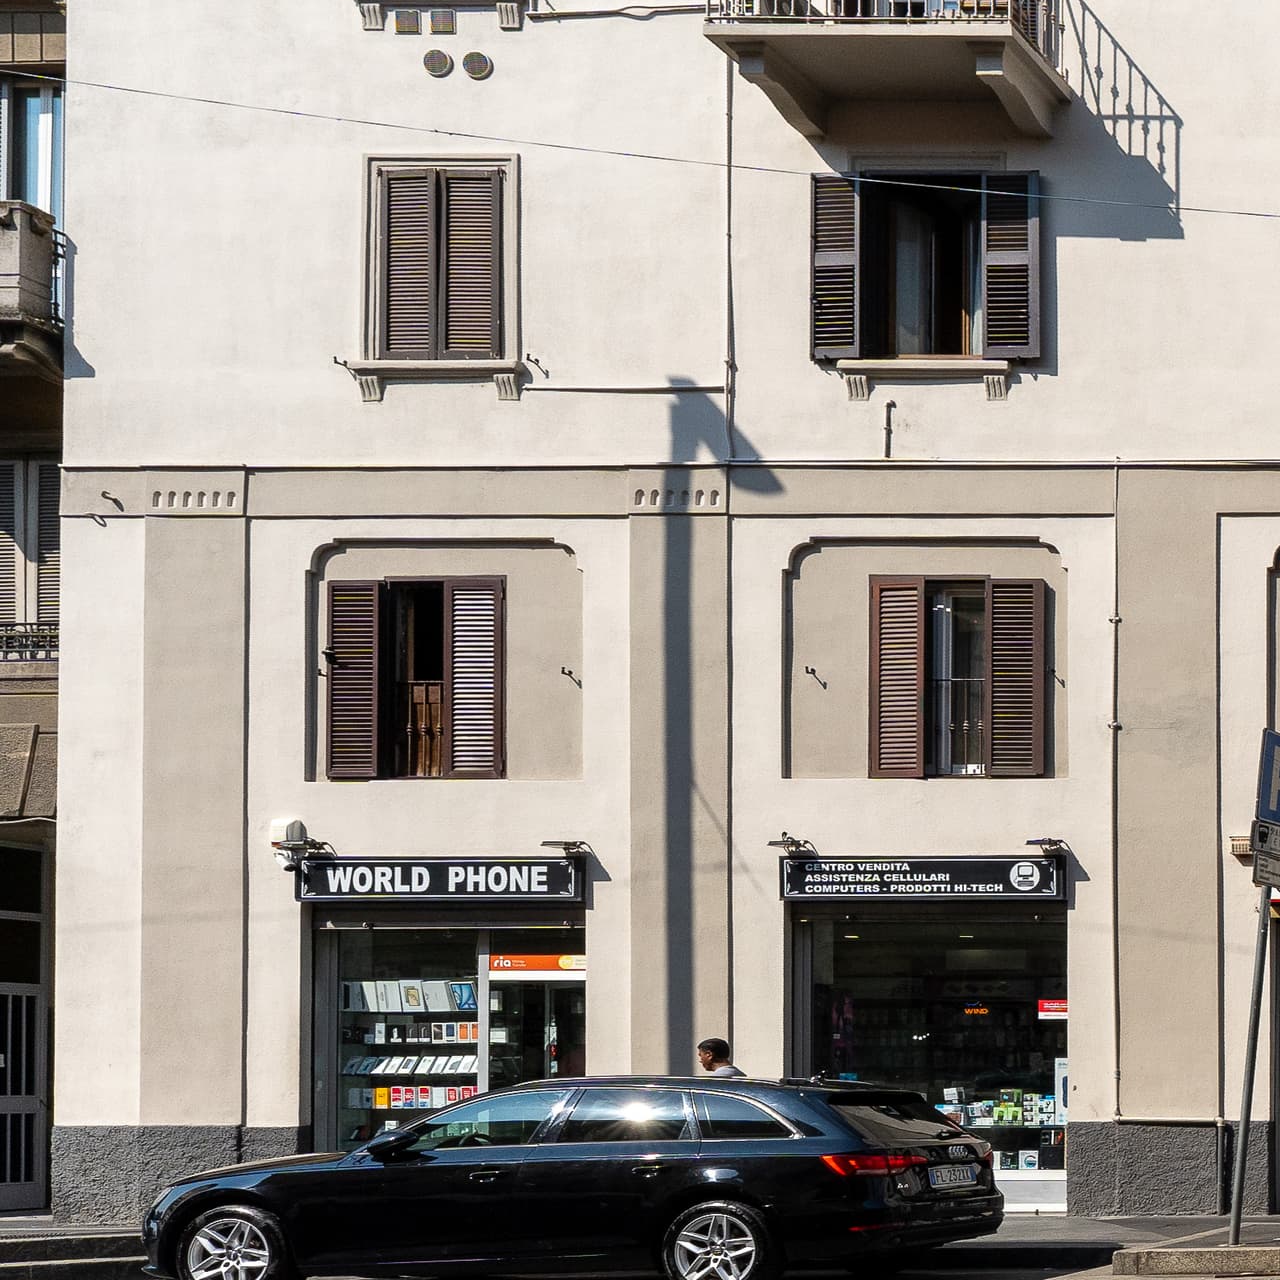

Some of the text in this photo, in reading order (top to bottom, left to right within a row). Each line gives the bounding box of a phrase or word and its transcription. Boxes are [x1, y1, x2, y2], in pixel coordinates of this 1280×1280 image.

[805, 863, 910, 872] CENTRO VENDITA
[326, 866, 548, 893] WORLD PHONE
[805, 873, 950, 882] ASSISTENZA CELLULARI
[805, 884, 880, 893] COMPUTERS
[890, 884, 951, 892] PRODOTTI
[954, 884, 1003, 892] HI-TECH
[494, 956, 512, 967] ria
